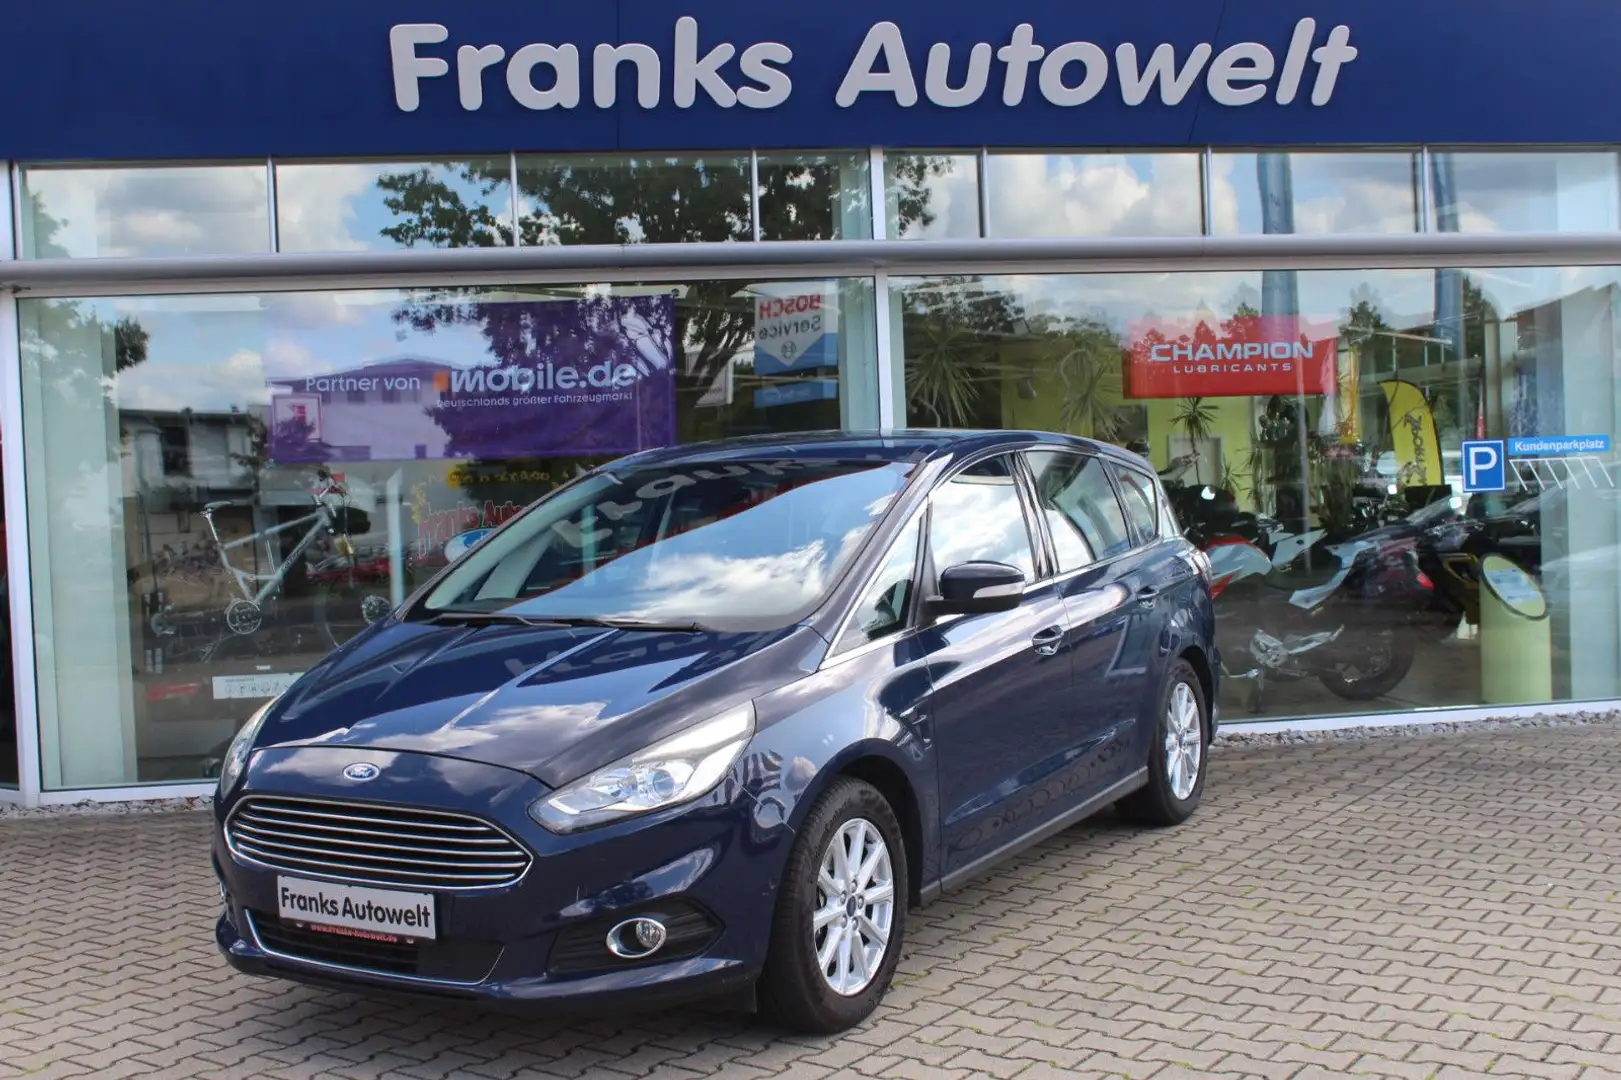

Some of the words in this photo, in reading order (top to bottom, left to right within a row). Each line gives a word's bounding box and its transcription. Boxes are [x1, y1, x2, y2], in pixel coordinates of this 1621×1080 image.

[389, 16, 794, 111] Franks
[835, 17, 1358, 108] Autowelt
[1151, 342, 1313, 361] CHAMPION
[305, 374, 378, 392] Partner
[384, 376, 421, 392] von
[451, 361, 637, 392] mobile.de
[1173, 363, 1293, 374] LUBRICANTS
[513, 394, 551, 407] größter
[1514, 438, 1605, 453] Kundenparkplatz
[1468, 446, 1498, 486] P
[281, 887, 339, 917] Franks
[342, 896, 430, 928] Autowelt
